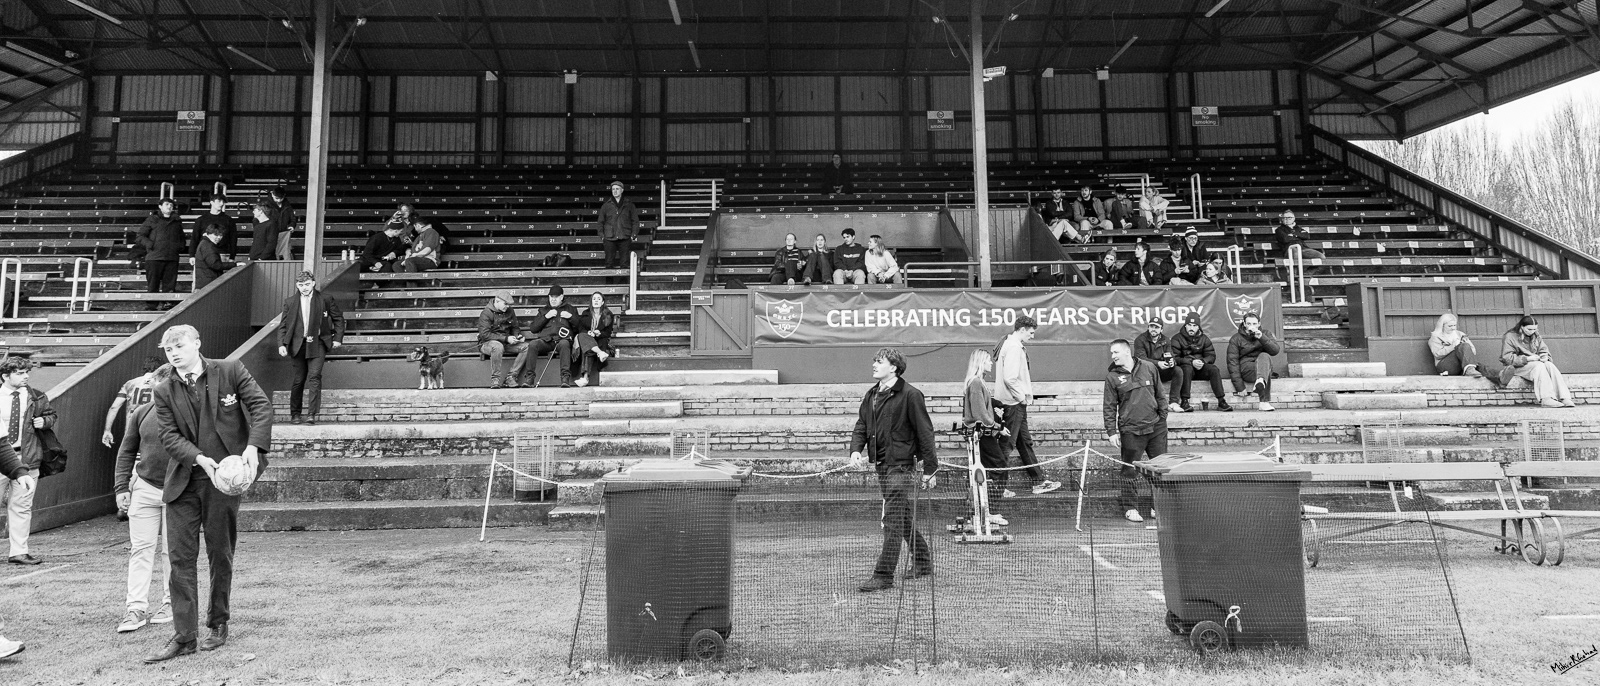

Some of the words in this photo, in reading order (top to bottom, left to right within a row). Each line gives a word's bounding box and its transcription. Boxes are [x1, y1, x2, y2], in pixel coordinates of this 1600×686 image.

[826, 309, 971, 327] CELEBRATING
[978, 308, 1016, 326] 150
[1022, 307, 1090, 326] YEARS
[1096, 306, 1124, 325] OF
[133, 388, 152, 405] 16
